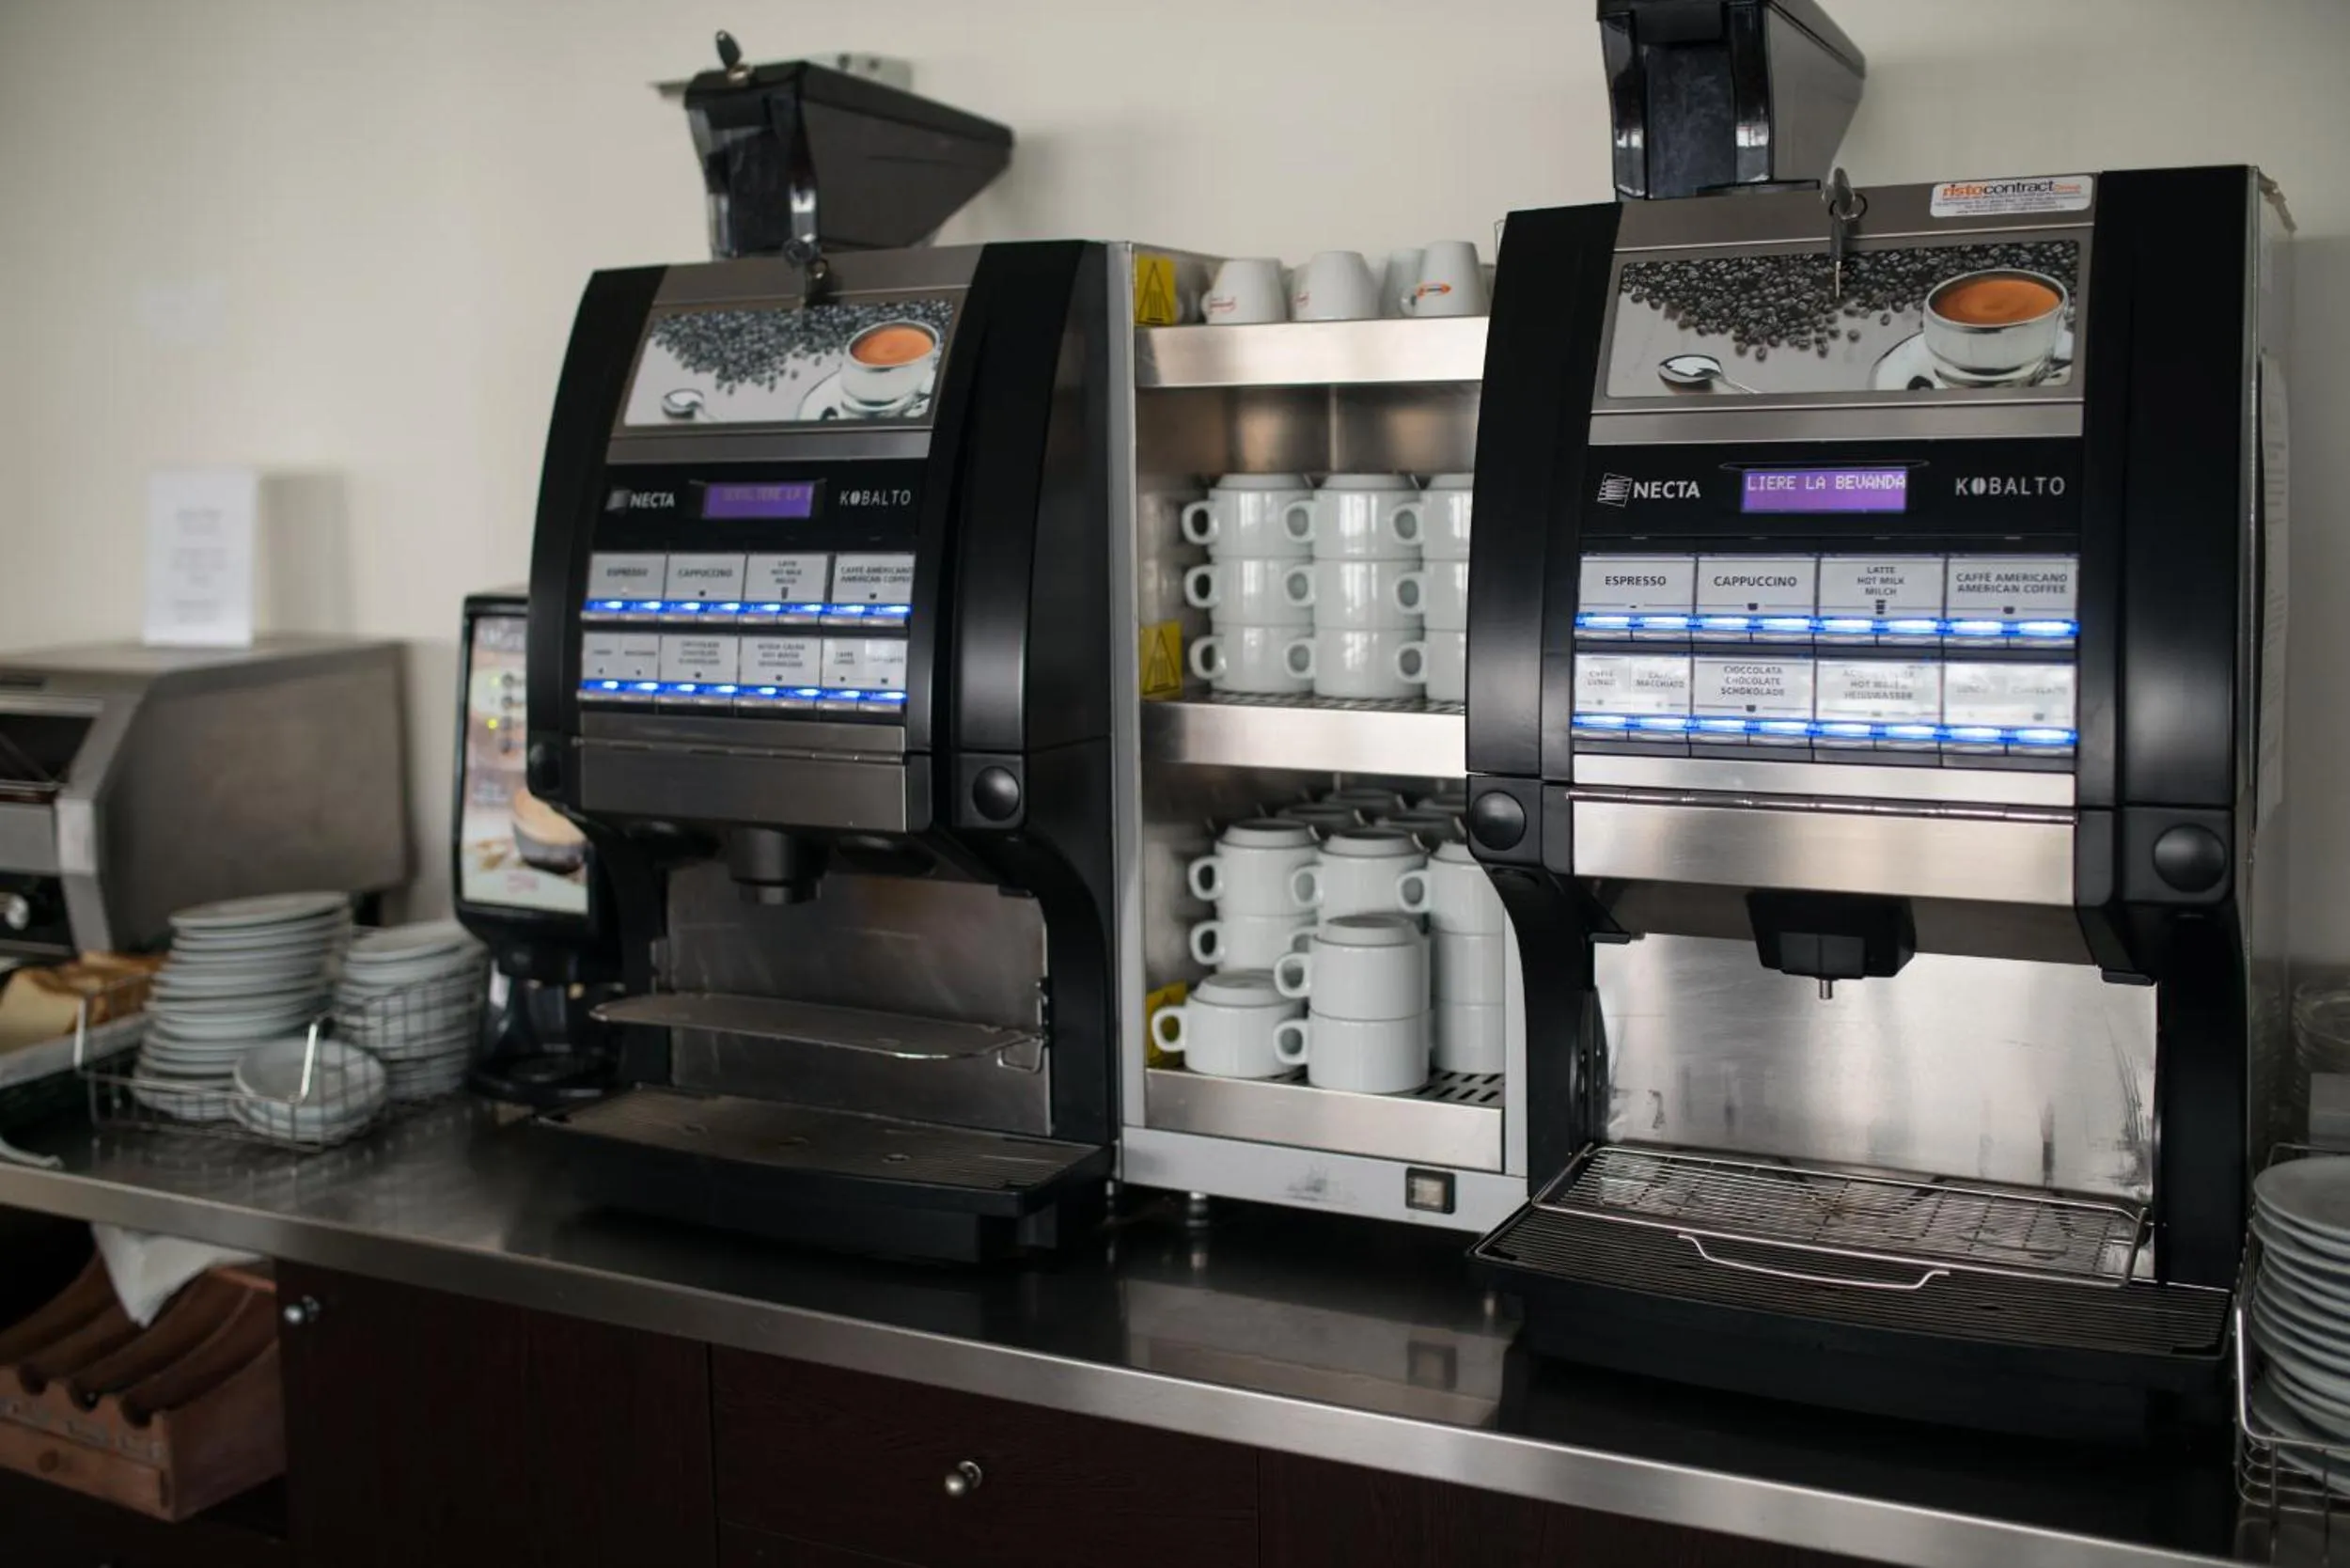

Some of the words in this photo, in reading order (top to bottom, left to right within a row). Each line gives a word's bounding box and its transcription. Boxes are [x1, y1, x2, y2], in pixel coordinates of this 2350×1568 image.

[1747, 475, 1796, 491] LIERE
[1805, 475, 1826, 490] LA
[1835, 474, 1906, 490] BEVANDA
[1955, 476, 2066, 496] KOBALTO
[1633, 480, 1701, 499] NECTA
[629, 492, 676, 509] NECTA
[838, 489, 912, 507] KOBALTO
[1866, 566, 1896, 574] LATTE
[1605, 575, 1667, 587] ESPRESSO
[1713, 575, 1797, 588] CAPPUCCINO
[1856, 576, 1876, 585] HOT
[1879, 576, 1904, 585] MILK
[1995, 572, 2068, 583] AMERICANO
[1864, 587, 1897, 596] MILCH
[1956, 584, 2020, 594] AMERICAN
[2023, 584, 2067, 594] COFFEE
[1723, 665, 1783, 675] CIOCCOLATA
[1725, 676, 1781, 686] CHOCOLATE
[1720, 686, 1785, 697] SCHOKOLADE
